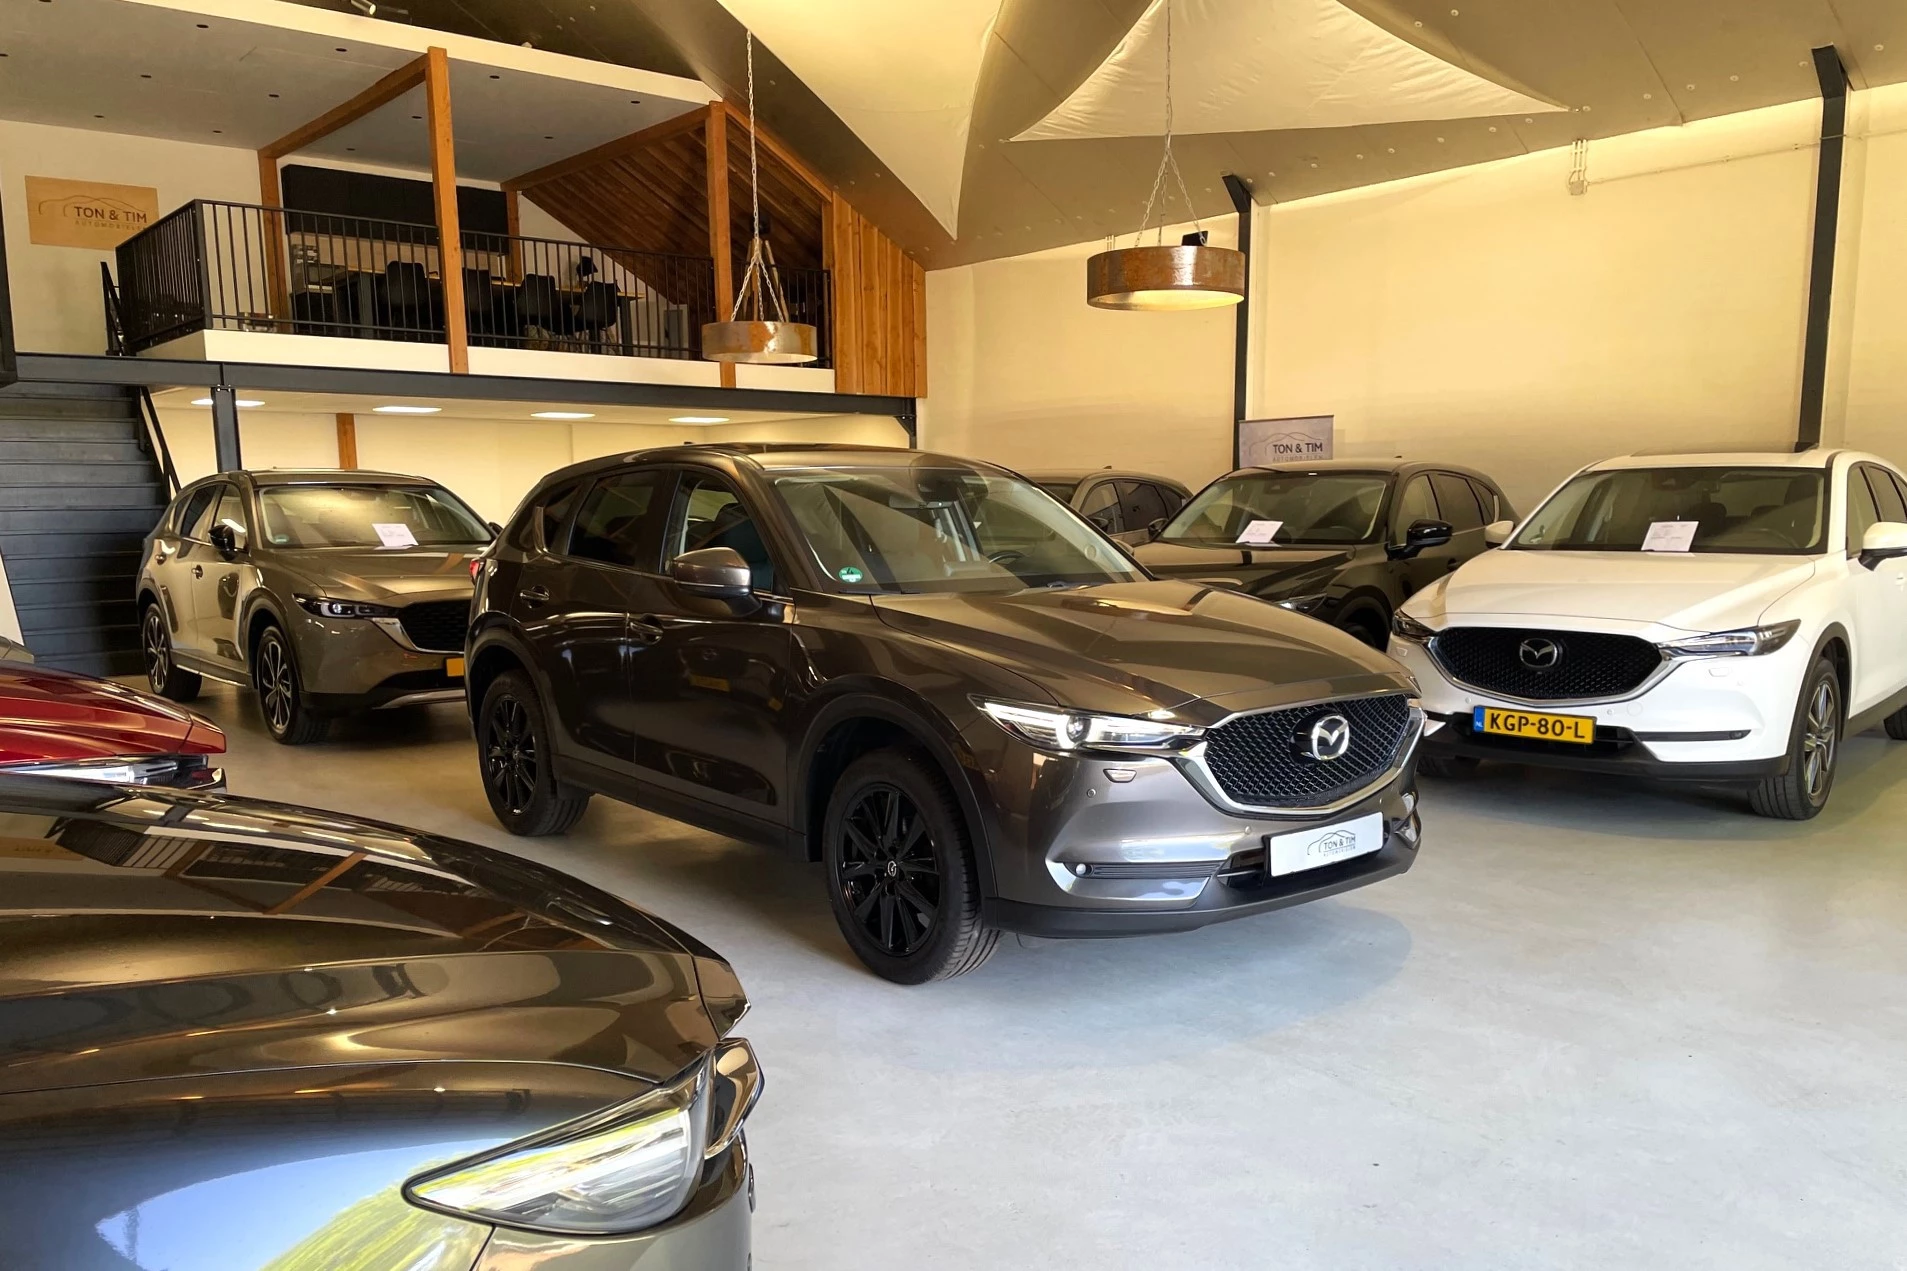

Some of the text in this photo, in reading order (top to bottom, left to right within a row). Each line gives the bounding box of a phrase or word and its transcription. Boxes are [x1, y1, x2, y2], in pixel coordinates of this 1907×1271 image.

[74, 206, 147, 223] TON & TIM
[1273, 442, 1323, 454] TON & TIM
[1490, 712, 1585, 739] KGP-80-L
[1323, 835, 1356, 850] TON & TIM
